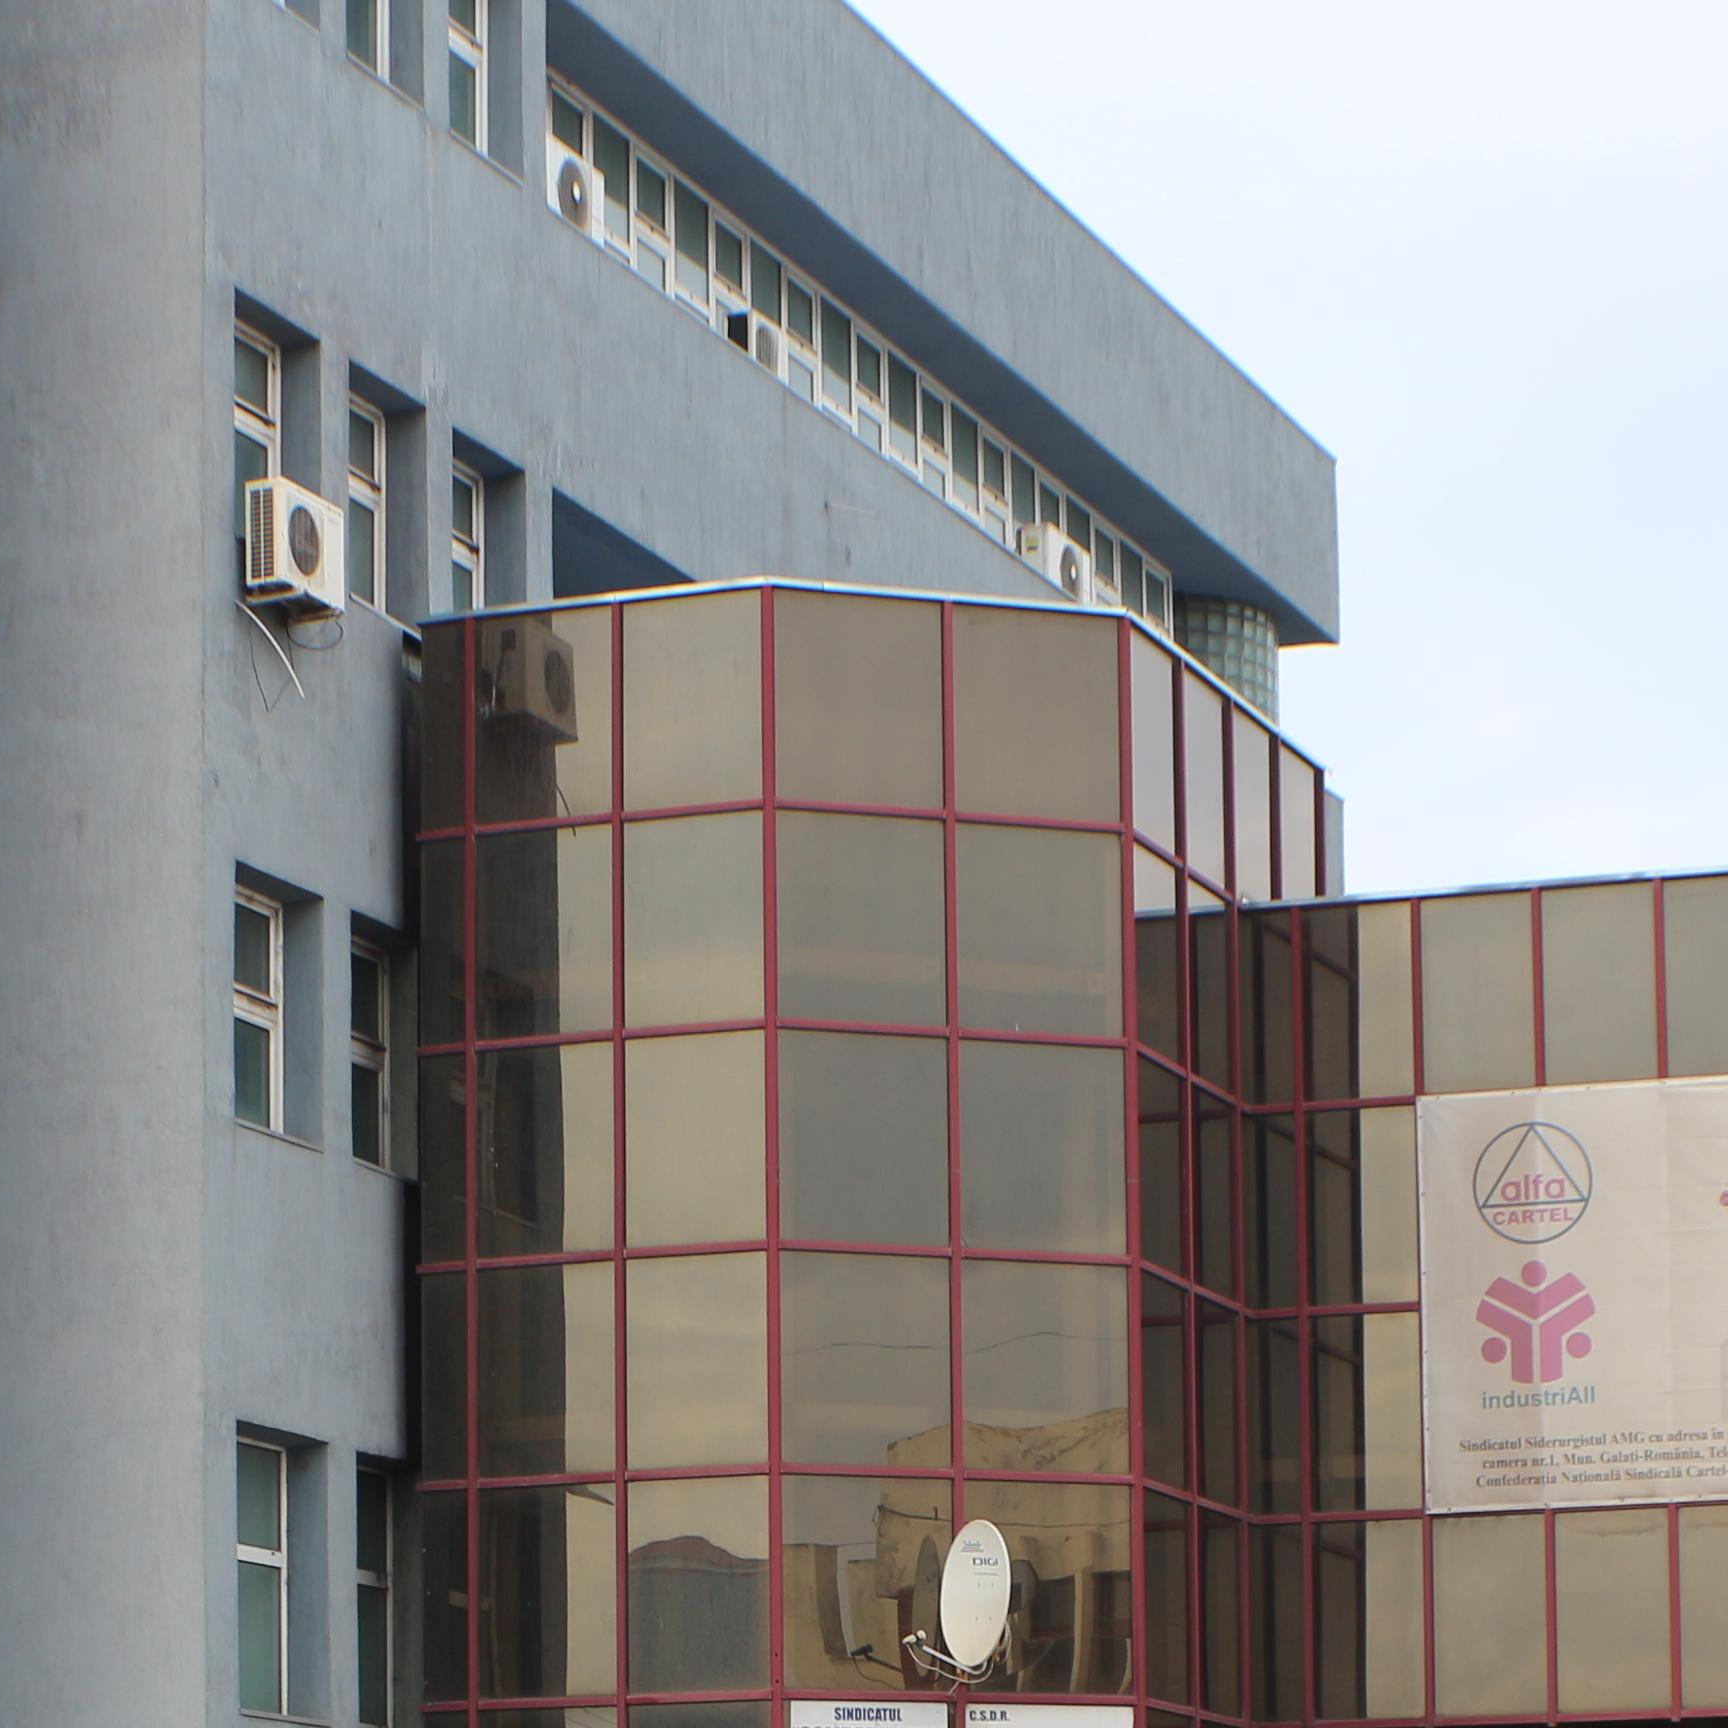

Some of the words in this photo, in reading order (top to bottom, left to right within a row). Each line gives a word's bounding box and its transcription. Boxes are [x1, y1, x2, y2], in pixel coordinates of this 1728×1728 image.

[1500, 1174, 1566, 1202] alfa
[1492, 1207, 1575, 1226] CARTEL
[1482, 1386, 1595, 1410] industriAll
[1459, 1437, 1522, 1452] Sindicatul
[1525, 1433, 1606, 1449] Siderurgistul
[1610, 1431, 1647, 1445] AMG
[1649, 1433, 1663, 1443] cu
[1667, 1429, 1708, 1442] adresa
[1483, 1458, 1527, 1469] camera
[1565, 1453, 1596, 1465] Mun.
[972, 1556, 999, 1568] DIGI
[834, 1707, 902, 1722] SINDICATUL
[969, 1710, 1010, 1722] C.S.D.R.
